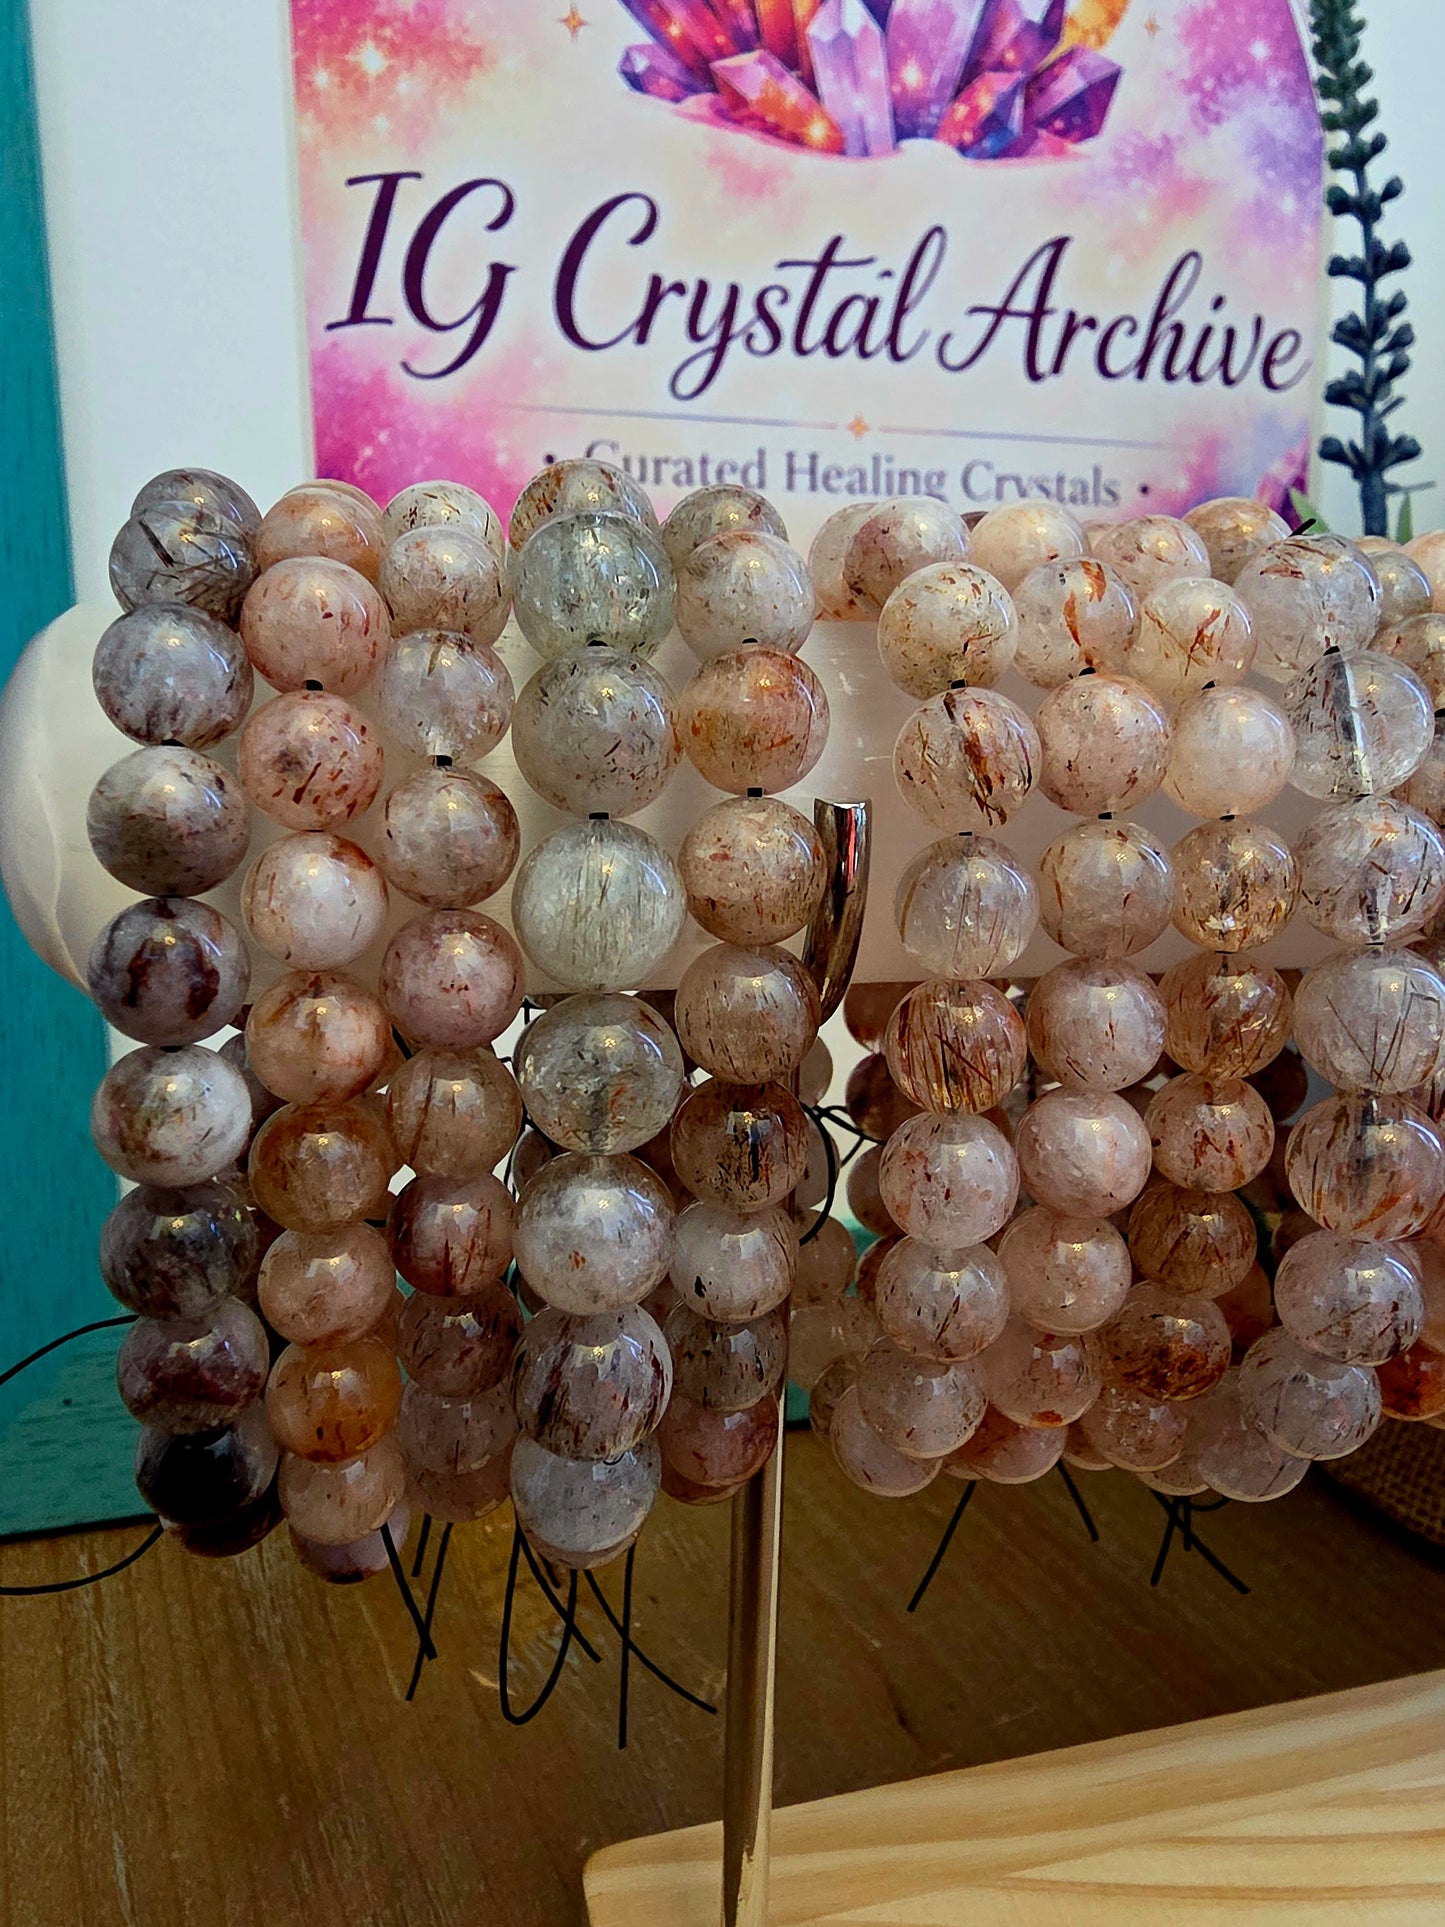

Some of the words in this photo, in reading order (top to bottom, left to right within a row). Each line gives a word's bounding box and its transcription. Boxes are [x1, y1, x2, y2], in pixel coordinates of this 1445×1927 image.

[326, 171, 517, 379] IG
[937, 232, 1313, 391] Archive
[786, 450, 948, 501] Healing
[961, 458, 1121, 506] Crystals
